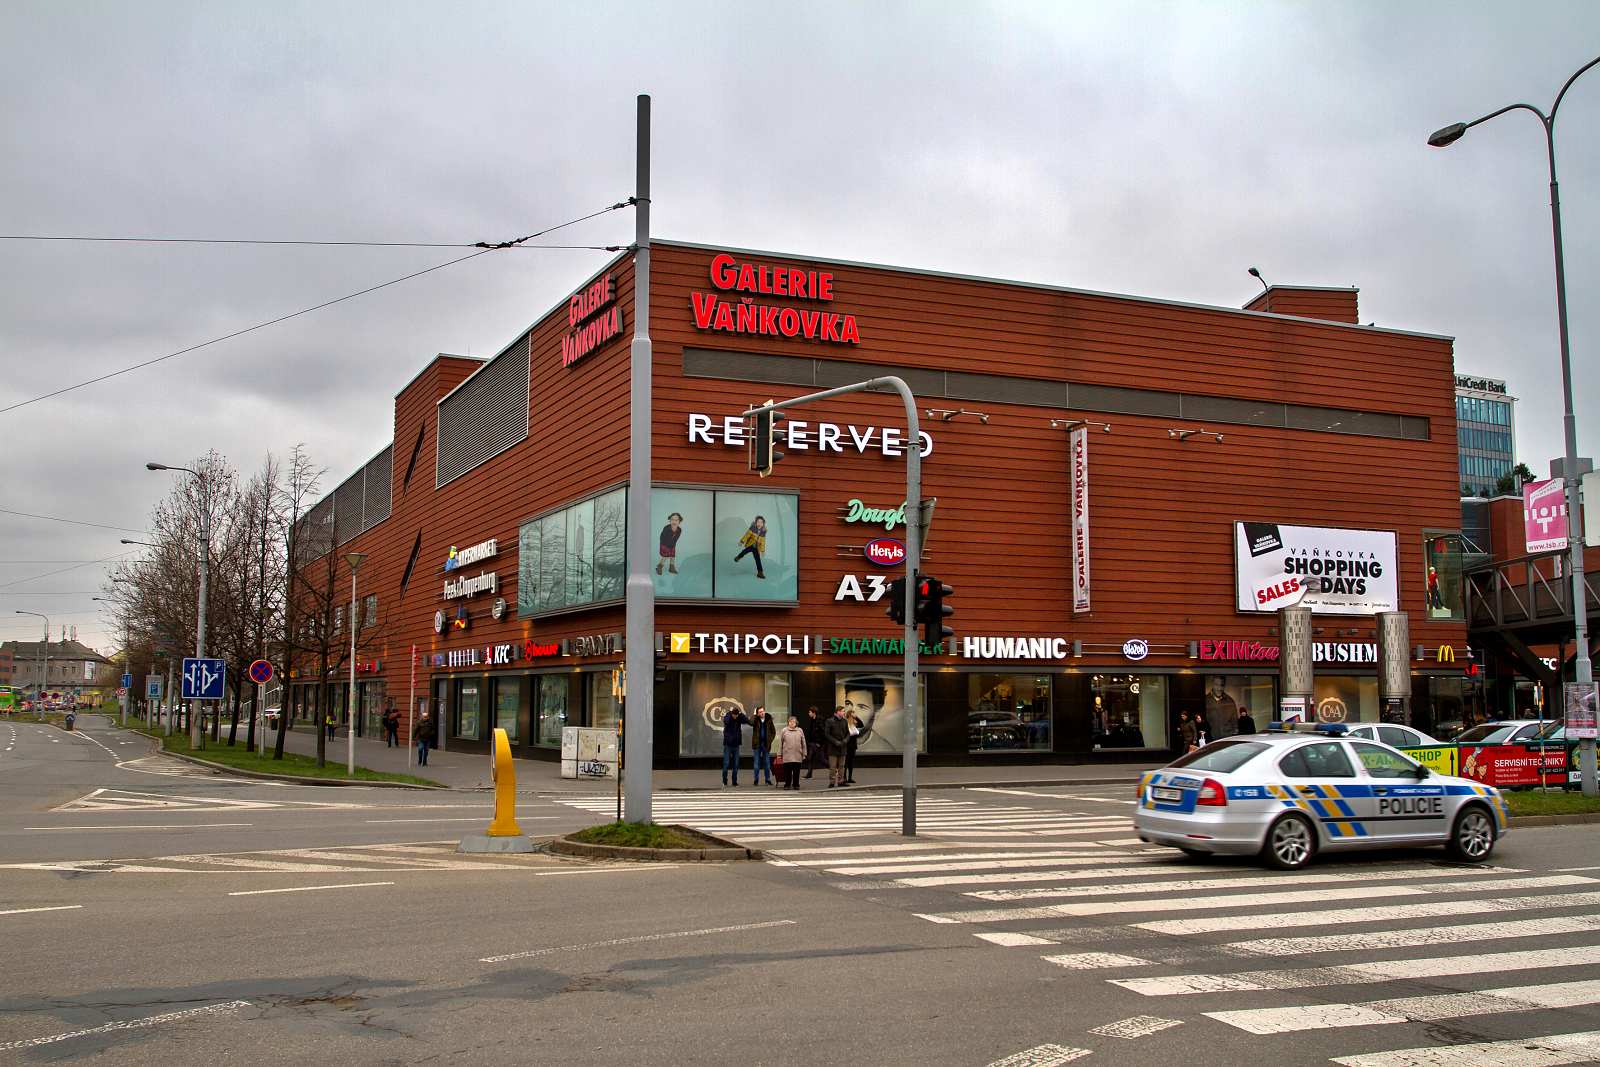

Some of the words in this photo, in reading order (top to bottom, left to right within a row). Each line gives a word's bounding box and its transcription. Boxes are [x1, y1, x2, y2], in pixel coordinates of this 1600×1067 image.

[711, 254, 834, 300] GALERIE
[569, 272, 611, 327] GALERIE
[691, 291, 861, 344] VAŇKOVKA
[1455, 376, 1487, 391] UniCredit
[1488, 380, 1506, 394] Bank
[688, 413, 933, 458] REERVED
[870, 544, 904, 560] Hervis
[1290, 547, 1376, 559] VAŇKOVKA
[1284, 556, 1383, 579] SHOPPING
[1256, 577, 1300, 604] SALES
[1320, 577, 1367, 596] DAYS
[694, 633, 809, 655] TRIPOLI
[963, 636, 1067, 660] HUMANIC
[493, 644, 511, 664] KFC
[1538, 656, 1558, 671] FC
[1322, 704, 1342, 718] C&A
[1411, 750, 1442, 762] SHOP
[1494, 757, 1528, 767] SERVISNÍ
[1380, 797, 1443, 815] POLICIE
